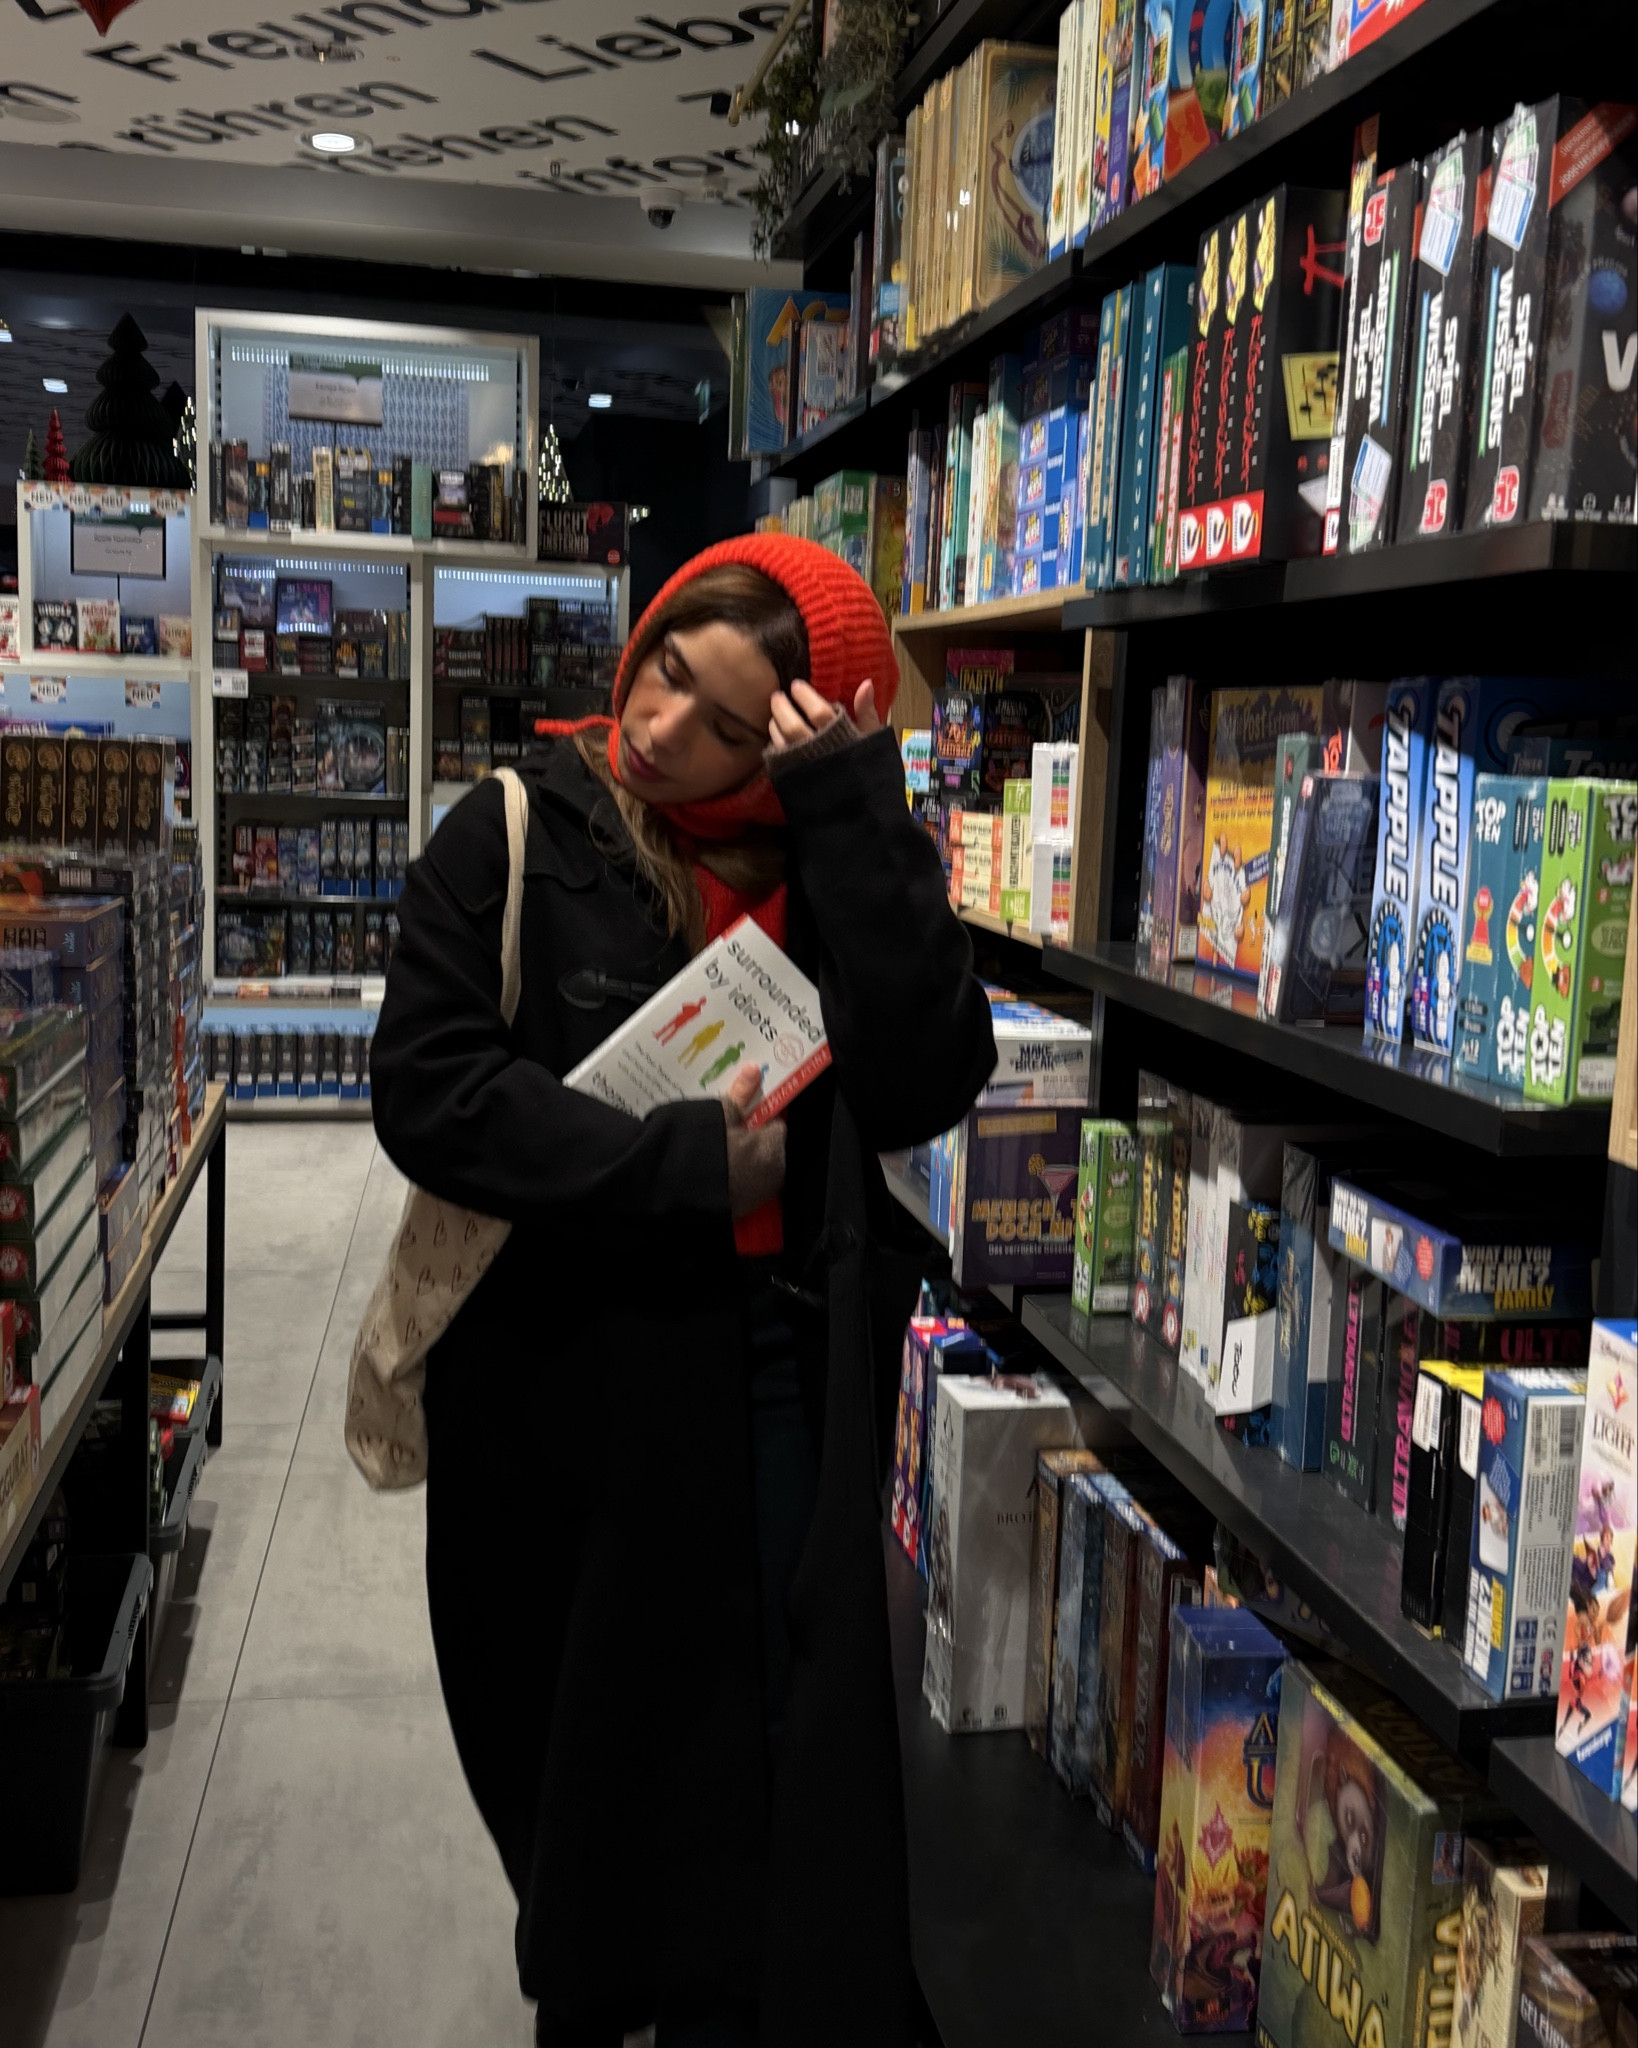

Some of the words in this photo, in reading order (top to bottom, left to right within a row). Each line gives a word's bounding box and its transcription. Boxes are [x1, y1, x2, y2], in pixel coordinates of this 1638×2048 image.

[31, 490, 53, 503] NEU
[69, 493, 91, 505] NEU
[101, 493, 123, 506] NEU
[156, 496, 178, 511] NEU
[37, 683, 60, 697] NEU
[131, 687, 154, 701] NEU
[1383, 705, 1411, 904] TAPPLE
[1430, 706, 1461, 911] TAPPLE
[1475, 796, 1507, 825] TOP
[1476, 821, 1502, 846] TEN
[704, 956, 730, 991] by
[727, 983, 778, 1043] idiots
[727, 939, 826, 1045] surrounded
[1462, 1245, 1504, 1265] WHAT
[1503, 1245, 1523, 1264] DO
[1524, 1245, 1553, 1264] YOU
[1460, 1263, 1551, 1294] MEME?
[1494, 1284, 1555, 1312] FAMILY
[1271, 1888, 1387, 2048] ATIWA
